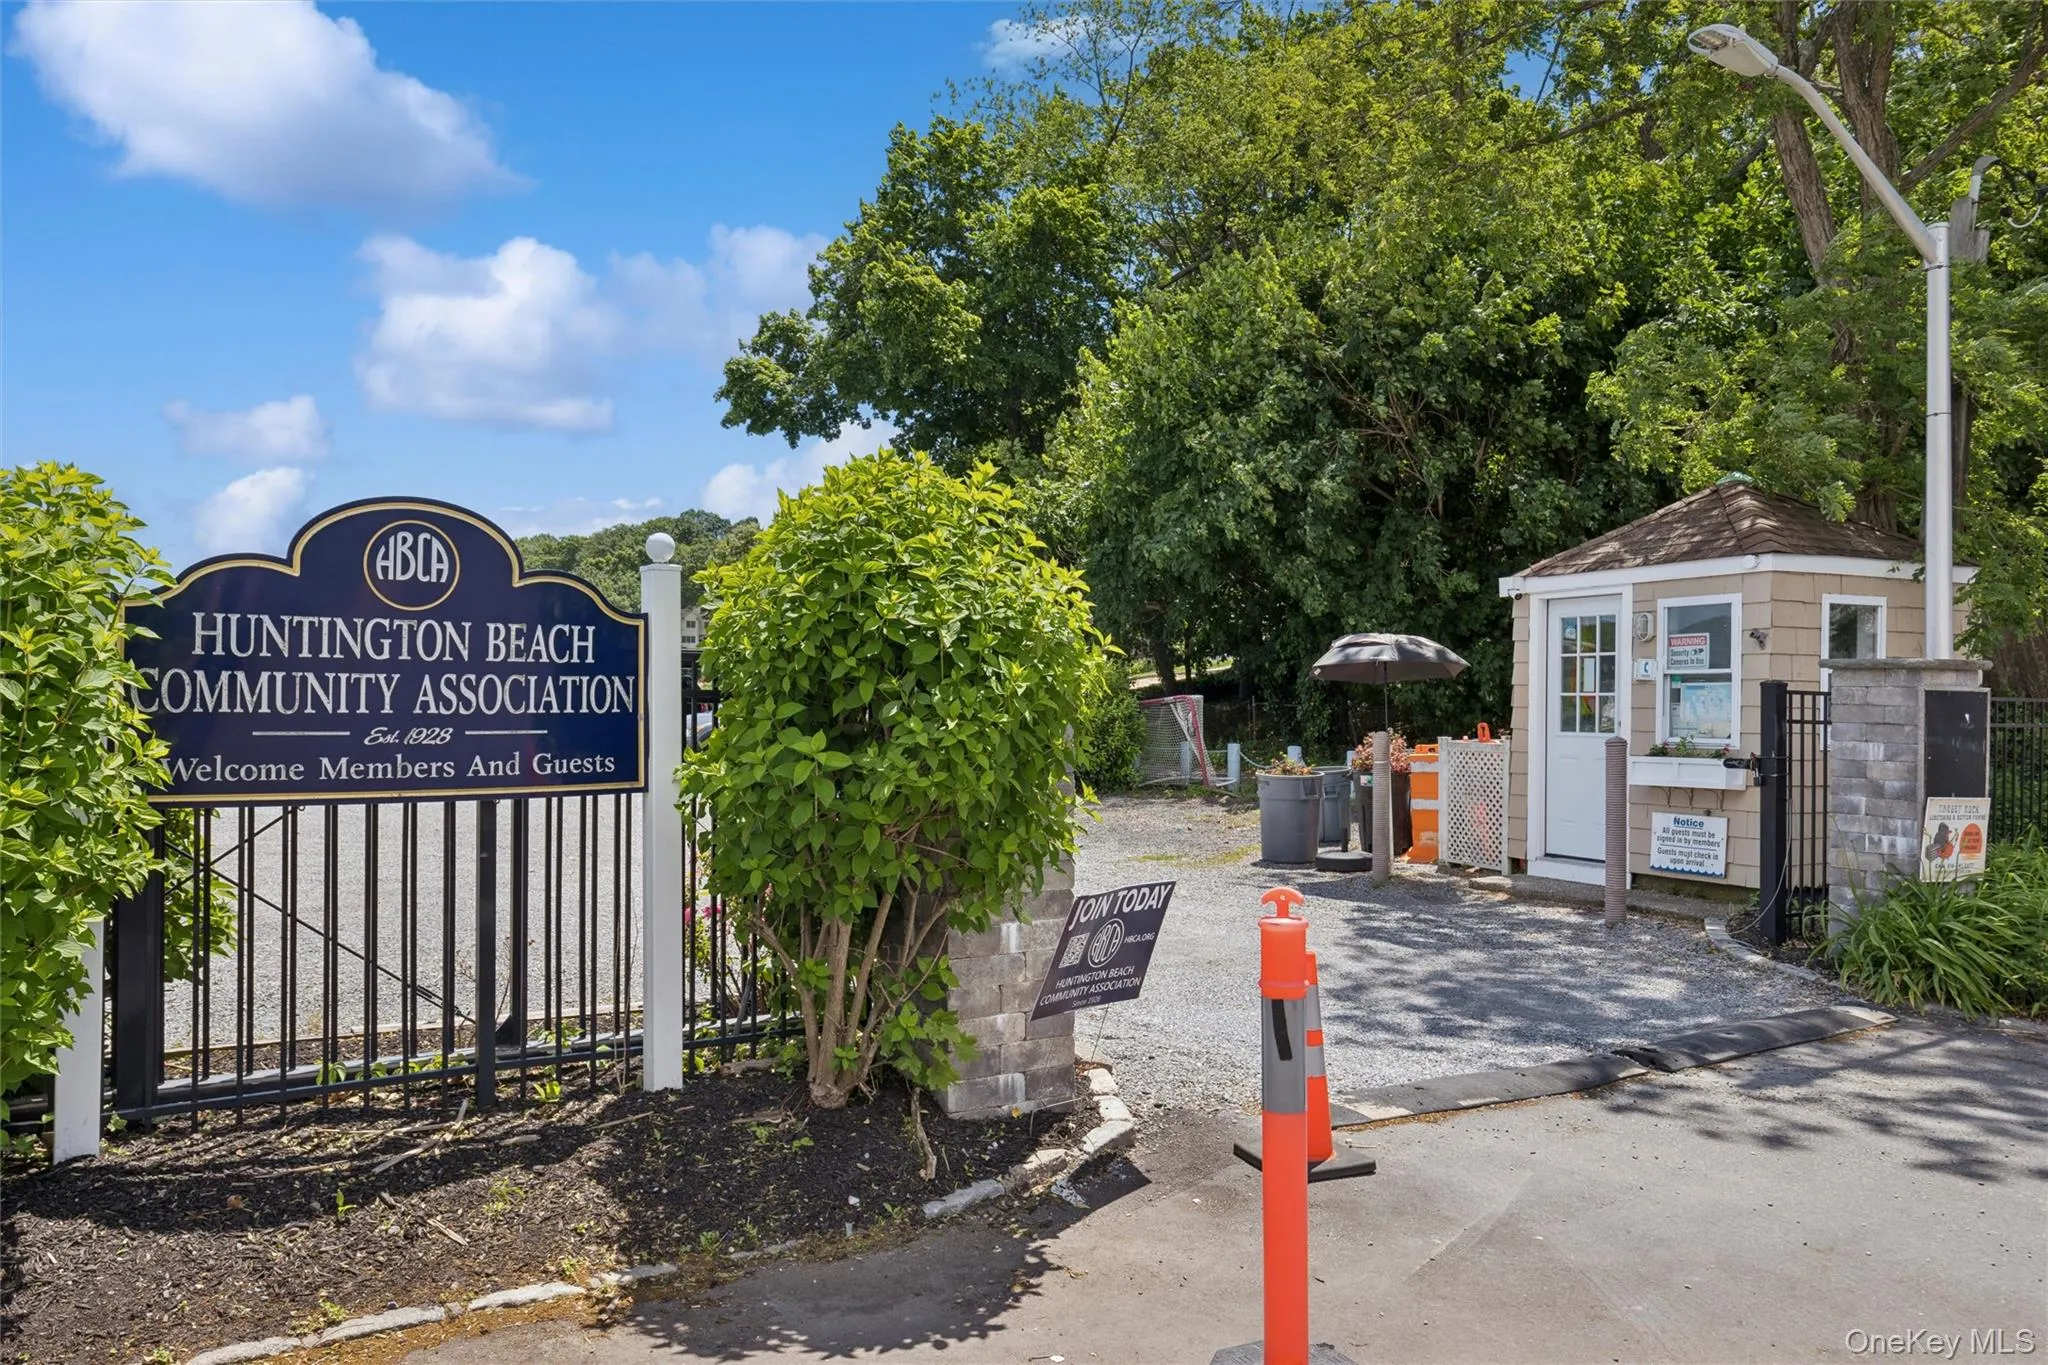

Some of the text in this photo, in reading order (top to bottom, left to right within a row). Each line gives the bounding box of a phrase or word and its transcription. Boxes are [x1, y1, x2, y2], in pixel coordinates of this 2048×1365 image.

[375, 531, 449, 583] HBCA
[192, 612, 595, 664] HUNTINGTON BEACH
[1670, 637, 1706, 646] WARNING
[130, 667, 635, 715] COMMUNITY ASSOCIATION
[363, 727, 453, 745] Est. 1928
[160, 751, 615, 782] Welcome Members And Guests
[1673, 816, 1704, 827] Notice
[1657, 835, 1676, 843] signed
[1684, 837, 1691, 845] by
[1692, 838, 1720, 847] members
[1657, 846, 1677, 856] Guests
[1678, 849, 1692, 857] must
[1694, 851, 1711, 859] check
[1068, 884, 1172, 931] JOIN TODAY
[1091, 923, 1121, 963] HBCA
[1124, 932, 1156, 944] HBCA.ORG
[1055, 966, 1135, 990] HUNTINGTON BEACH
[1039, 977, 1141, 1006] COMMUNITY ASSOCIATION
